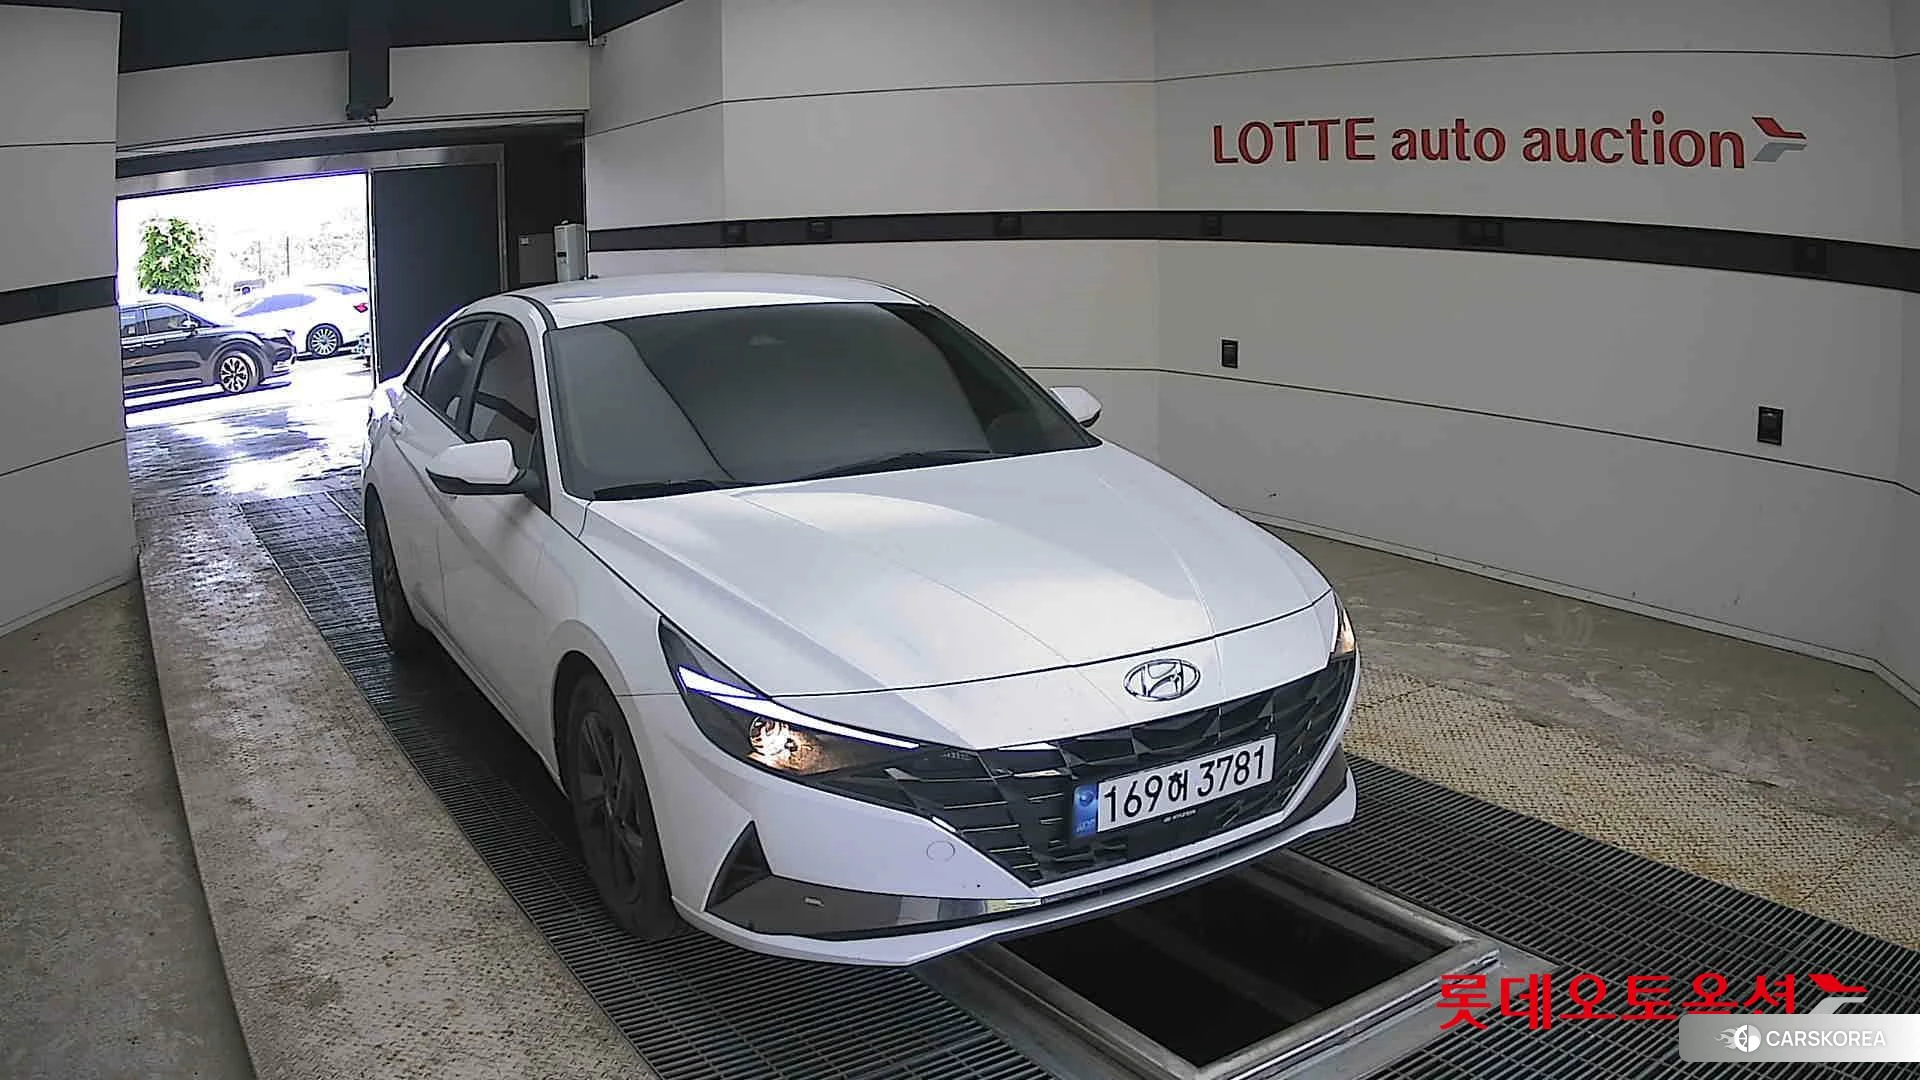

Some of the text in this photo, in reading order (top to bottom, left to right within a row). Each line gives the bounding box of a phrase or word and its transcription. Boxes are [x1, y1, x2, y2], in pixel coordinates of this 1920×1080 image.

[1212, 110, 1745, 169] LOTTE auto auction
[1197, 745, 1265, 797] 3781
